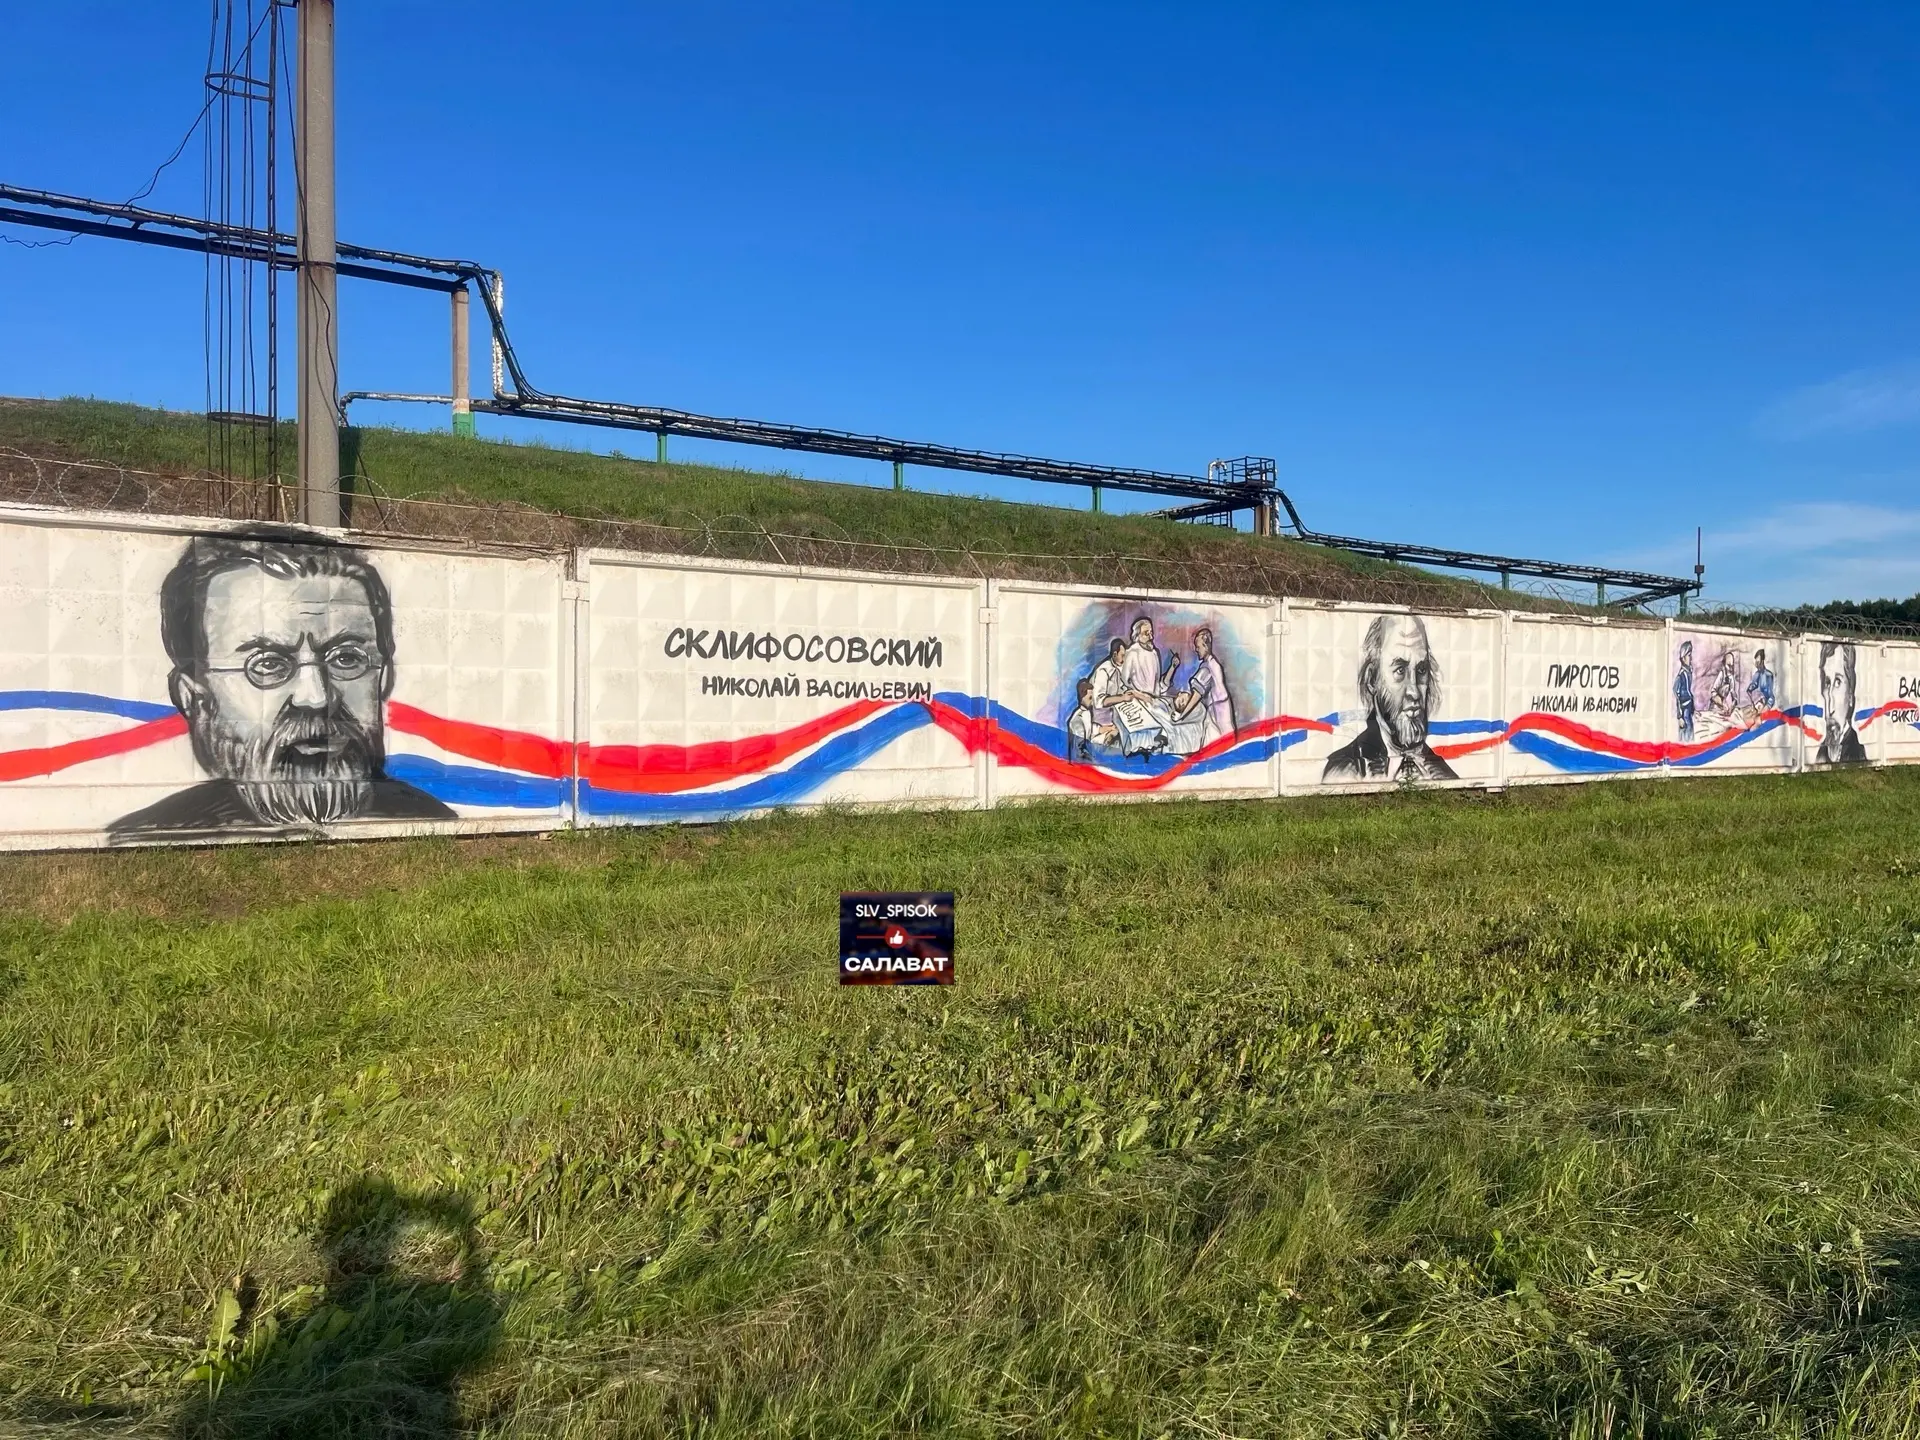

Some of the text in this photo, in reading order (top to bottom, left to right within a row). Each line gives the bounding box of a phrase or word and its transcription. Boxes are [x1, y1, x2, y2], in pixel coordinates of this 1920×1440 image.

[664, 627, 943, 669] СКЛИФОСОВСКИЙ
[702, 673, 931, 702] НИКОЛАЙ ВАСИЛЬЕВИЧ
[1547, 664, 1620, 689] ПИРОГОВ
[1531, 692, 1638, 714] НИКОЛАЙ ИВАНОВИЧ
